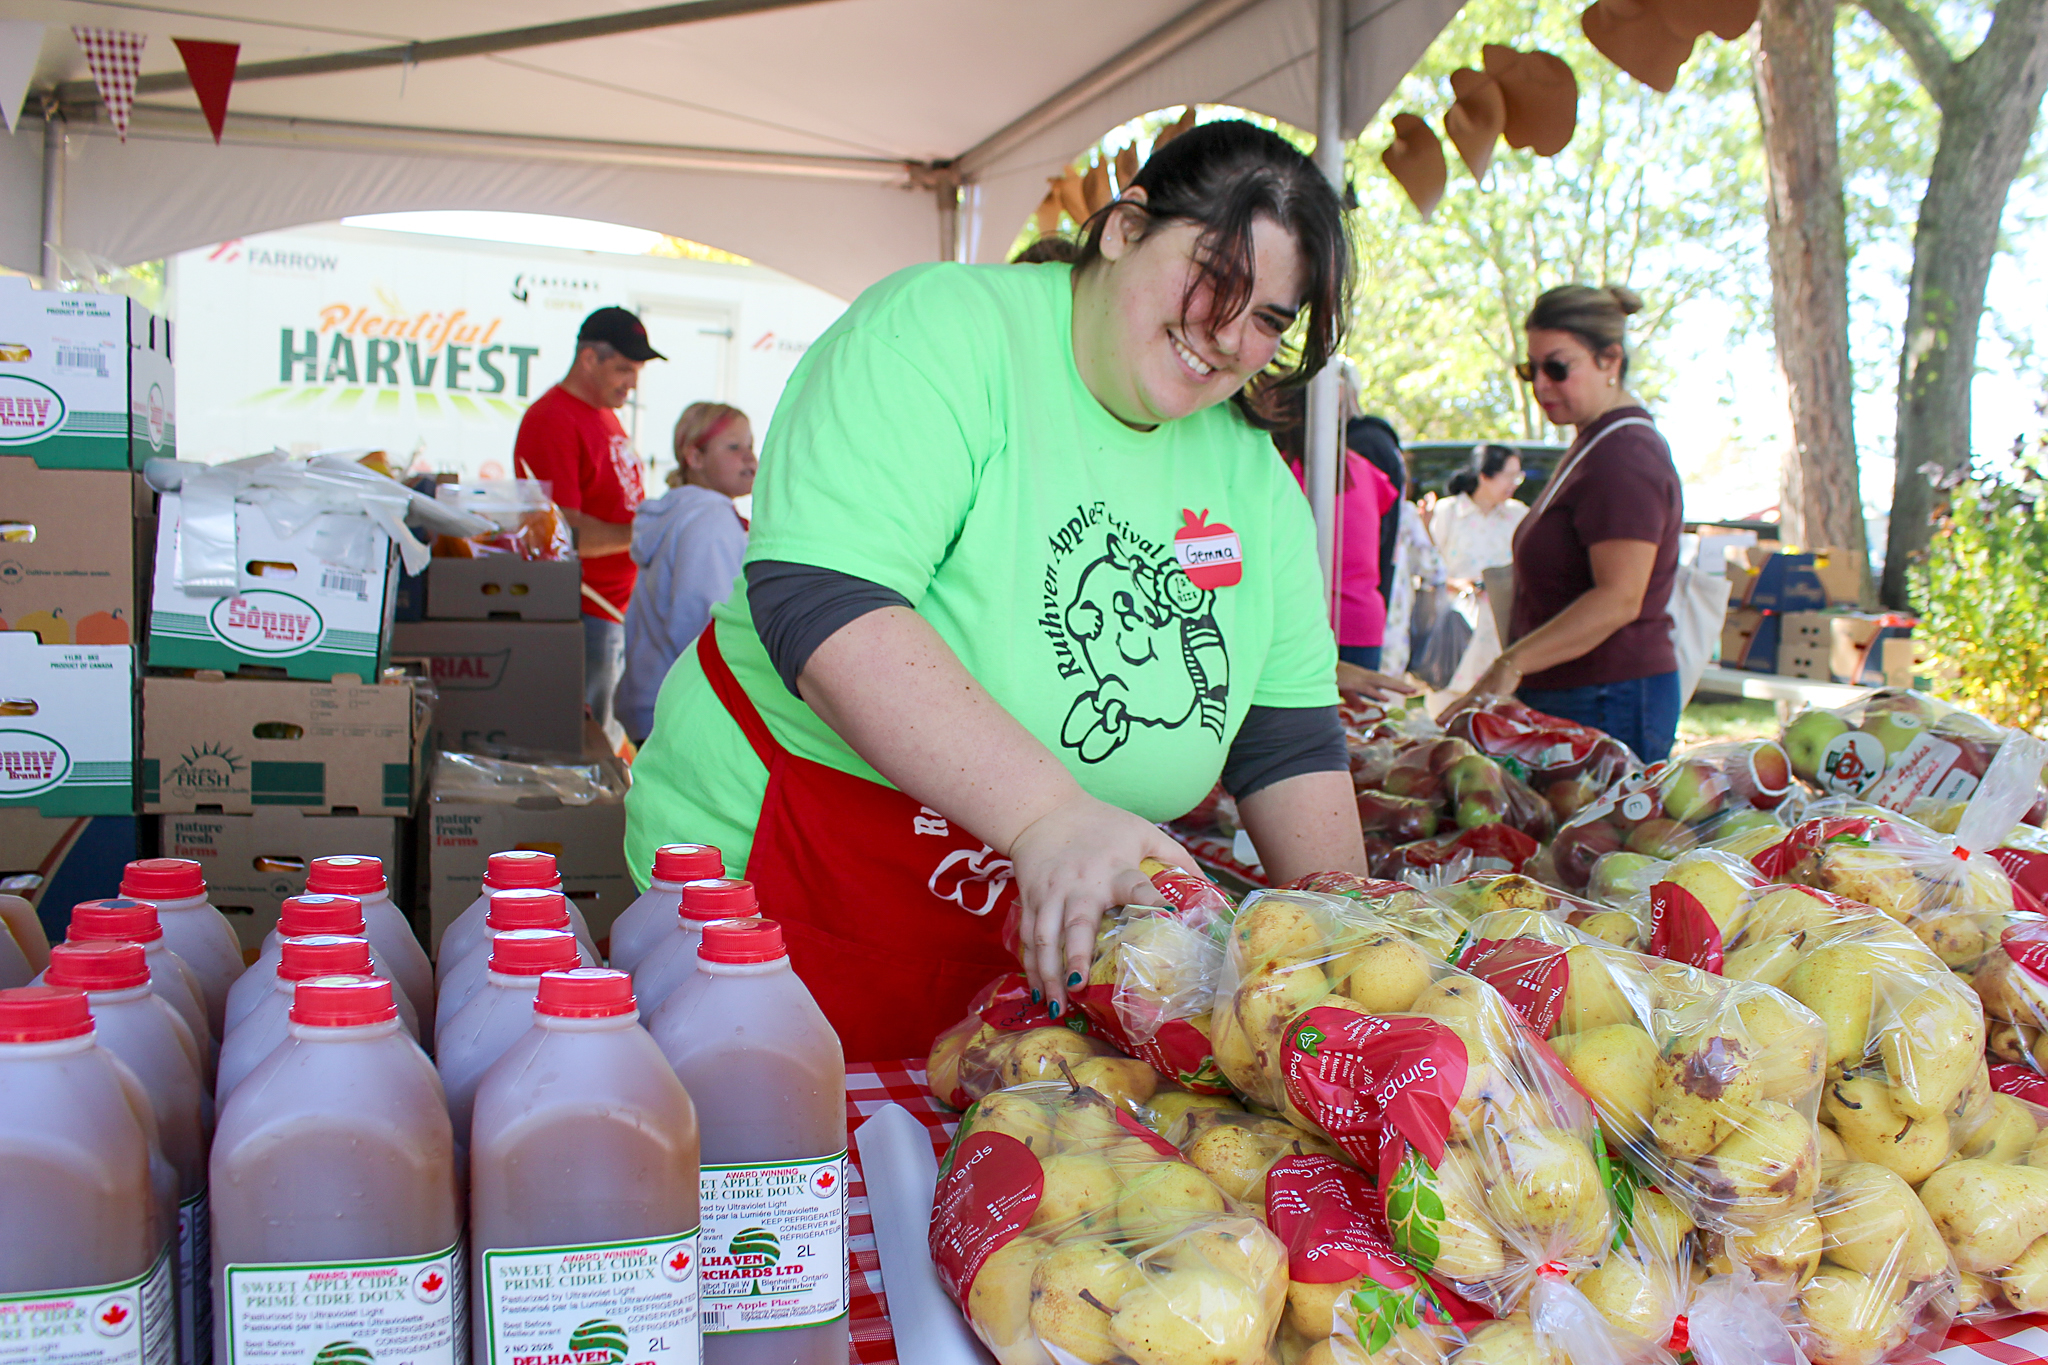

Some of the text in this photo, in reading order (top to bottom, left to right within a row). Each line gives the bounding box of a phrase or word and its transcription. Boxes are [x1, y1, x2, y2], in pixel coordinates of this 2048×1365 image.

[248, 248, 338, 272] FARROW
[46, 308, 75, 316] PRODUCT
[86, 309, 111, 318] CANADA
[319, 302, 502, 356] Plentiful
[280, 327, 540, 398] HARVEST
[1185, 544, 1235, 565] Gemma
[229, 597, 311, 642] Sonny
[1038, 566, 1085, 680] Ruthven
[432, 658, 490, 679] RIAL
[177, 774, 230, 787] FRESH
[174, 822, 223, 834] nature
[435, 815, 482, 826] nature
[435, 825, 473, 836] fresh
[175, 833, 213, 844] fresh
[436, 836, 479, 847] farms
[174, 845, 218, 857] farms
[1538, 986, 1564, 1023] Canada
[1343, 1018, 1363, 1031] Empire
[1318, 1055, 1329, 1080] Cortland
[1329, 1057, 1340, 1083] McIntosh
[1342, 1060, 1351, 1078] Mutsu
[1376, 1057, 1438, 1108] Simps
[726, 1168, 799, 1179] AWARD WINNING
[1270, 1167, 1325, 1178] of Canada
[720, 1174, 807, 1189] APPLE CIDER
[722, 1188, 764, 1200] CIDRE
[767, 1185, 805, 1197] DOUX
[1021, 1193, 1037, 1203] Gold
[715, 1204, 726, 1213] by
[727, 1202, 766, 1211] Ultraviolet
[768, 1200, 787, 1209] Light
[716, 1213, 729, 1221] par
[730, 1211, 738, 1219] la
[773, 1206, 819, 1216] Ultraviolette
[761, 1208, 841, 1226] KEEP REFRIGERATED
[779, 1218, 837, 1233] CONSERVER au
[950, 1221, 962, 1236] kg
[562, 1248, 648, 1264] AWARD WINNING
[797, 1244, 816, 1258] 2L
[1306, 1241, 1406, 1267] Orchards
[500, 1255, 658, 1278] SWEET APPLE CIDER
[702, 1254, 763, 1266] LHAVEN
[308, 1271, 347, 1281] AWARD
[559, 1273, 608, 1288] CIDRE
[612, 1267, 656, 1283] DOUX
[702, 1265, 804, 1280] RCHARDS LTD
[241, 1275, 410, 1296] SWEET APPLE CIDER
[723, 1281, 740, 1289] Trail
[762, 1278, 799, 1287] Blenheim,
[801, 1273, 829, 1282] Ontario
[552, 1293, 563, 1303] by
[613, 1286, 636, 1297] Light
[728, 1287, 747, 1295] Fruit
[772, 1284, 790, 1292] Fruit
[303, 1291, 354, 1306] CIDRE
[359, 1289, 407, 1303] DOUX
[606, 1292, 696, 1316] KEEP REFRIGERATED
[712, 1298, 800, 1311] The Apple Place
[552, 1303, 568, 1313] par
[627, 1309, 684, 1323] CONSERVER
[524, 1321, 552, 1329] Before
[649, 1336, 671, 1353] 2L
[513, 1350, 609, 1365] DELHAVEN
